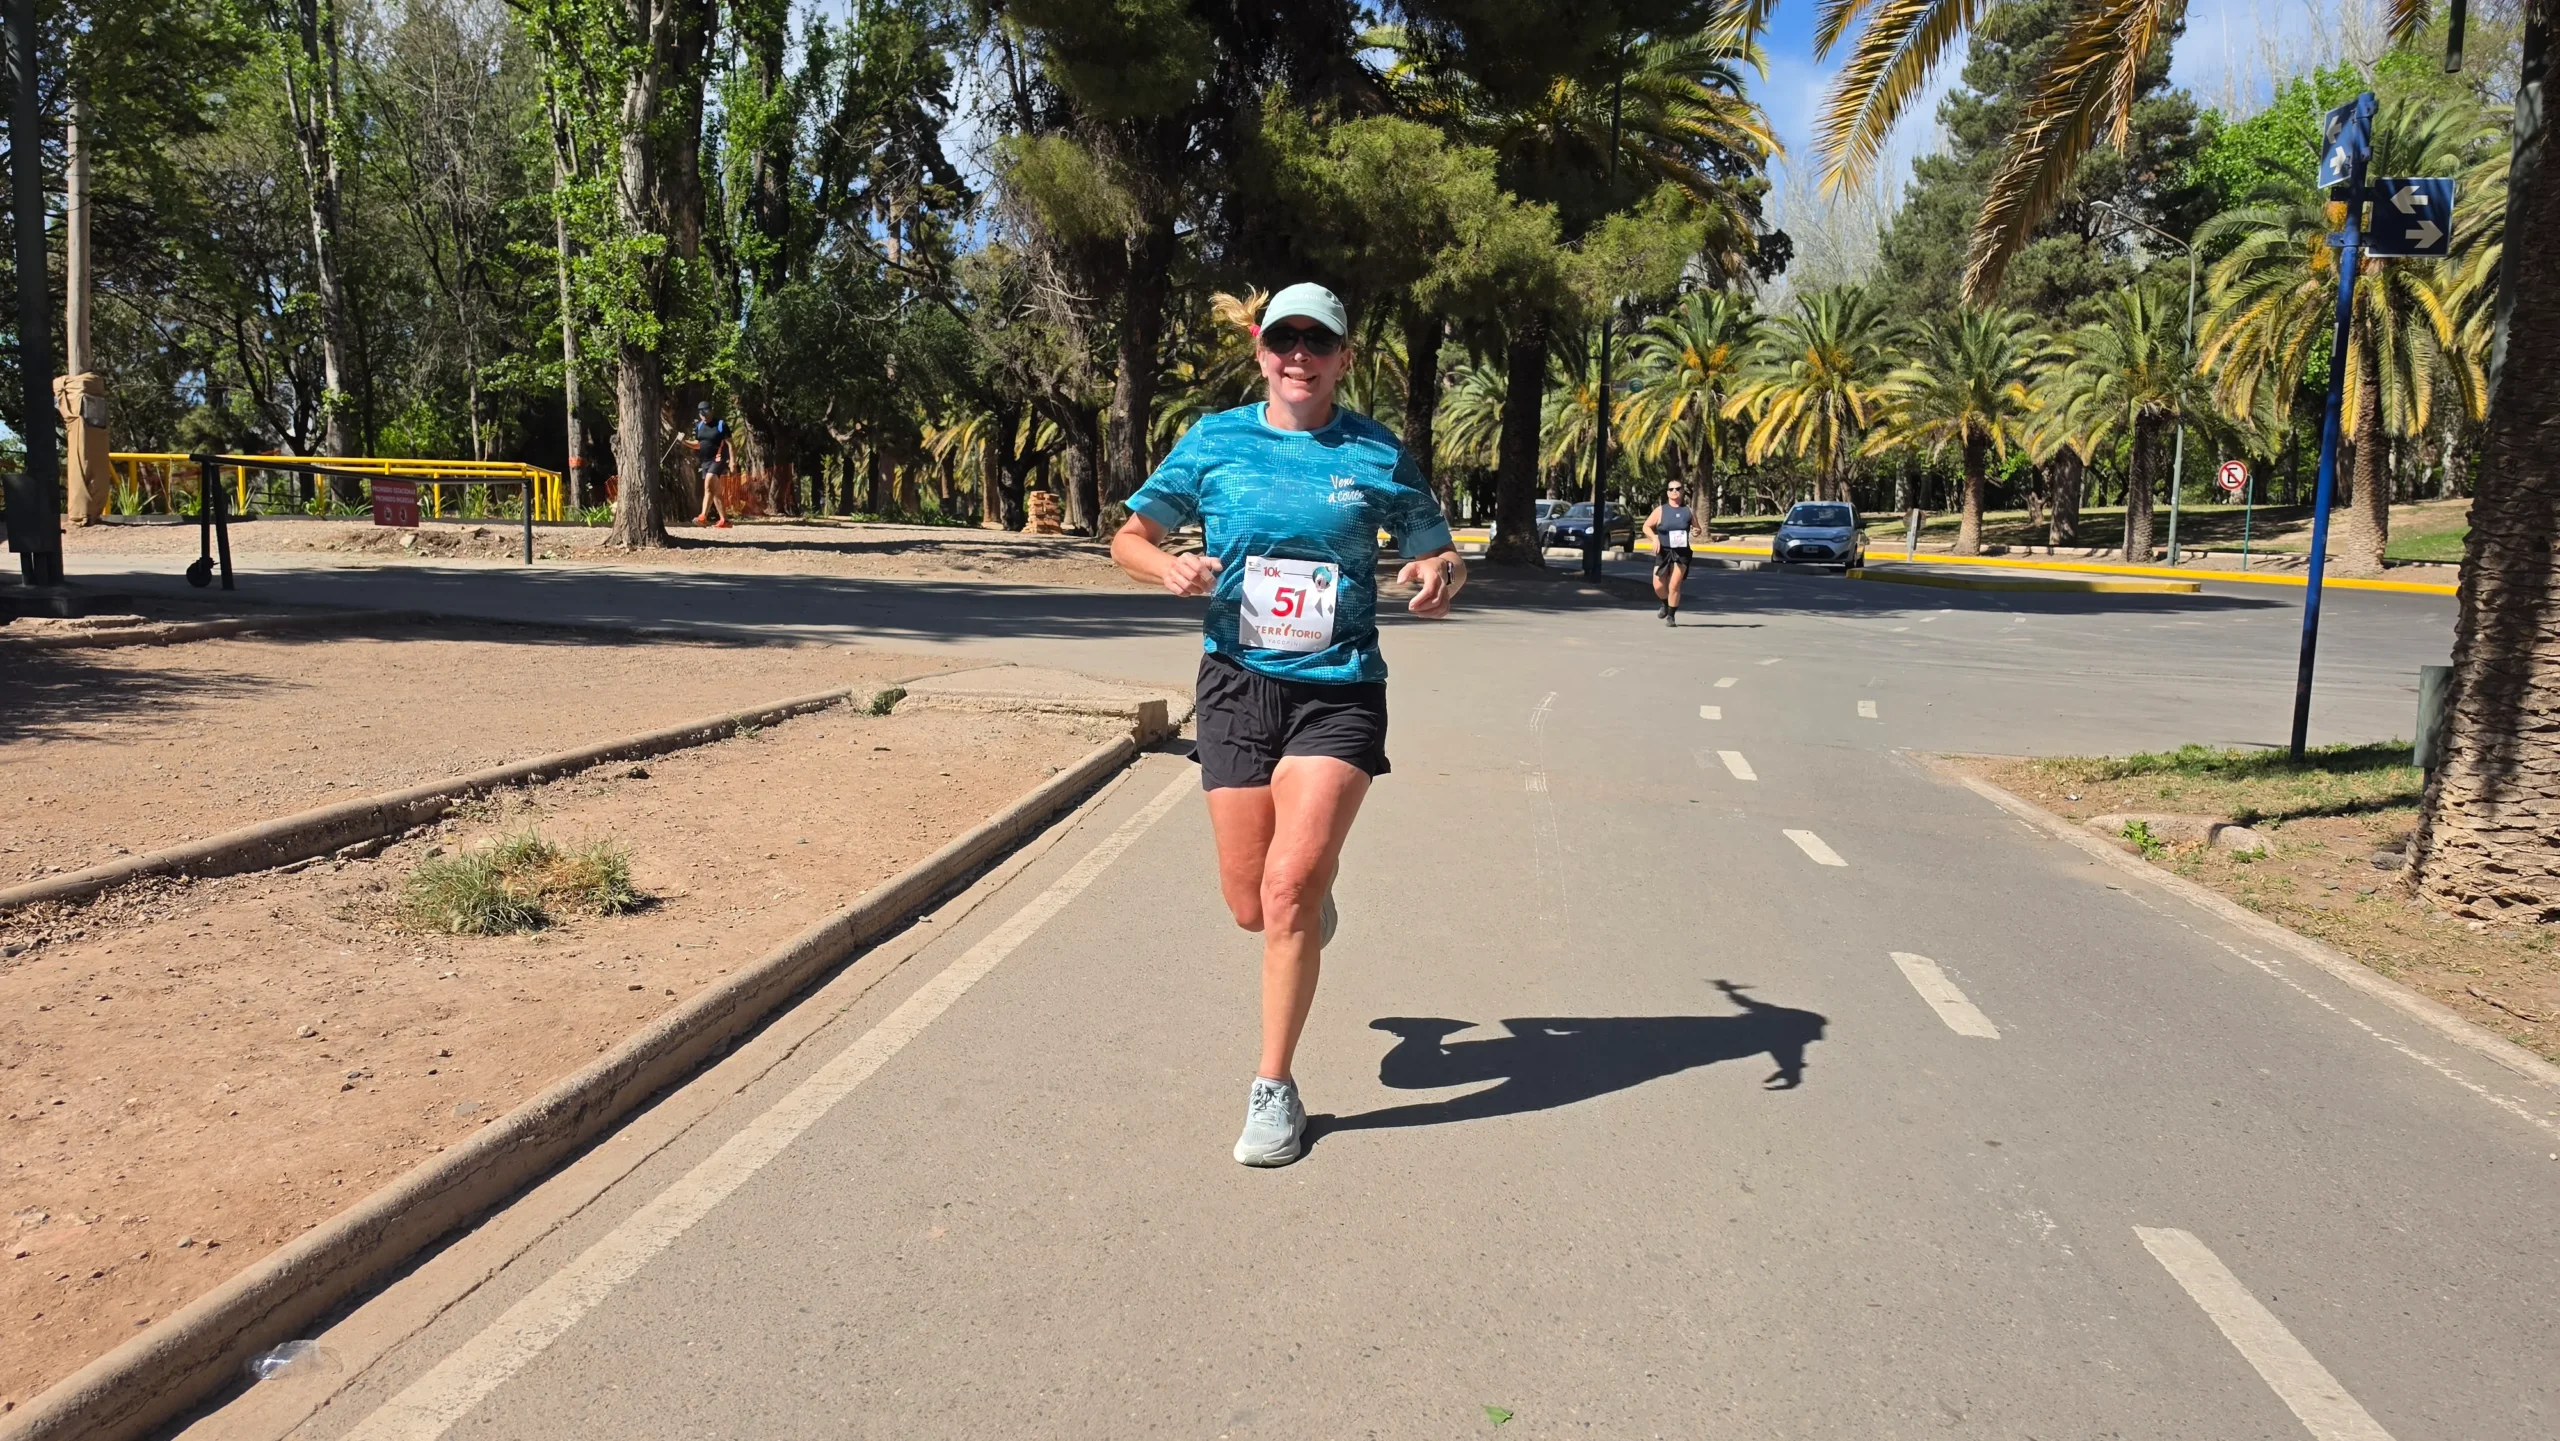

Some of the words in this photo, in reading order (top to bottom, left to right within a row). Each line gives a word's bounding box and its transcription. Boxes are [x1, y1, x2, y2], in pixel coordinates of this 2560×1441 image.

[1328, 490, 1337, 503] a
[1263, 566, 1281, 578] 10k
[1271, 586, 1307, 618] 51
[1255, 623, 1322, 640] TERRITORIO
[1268, 638, 1301, 647] YACOPINI
